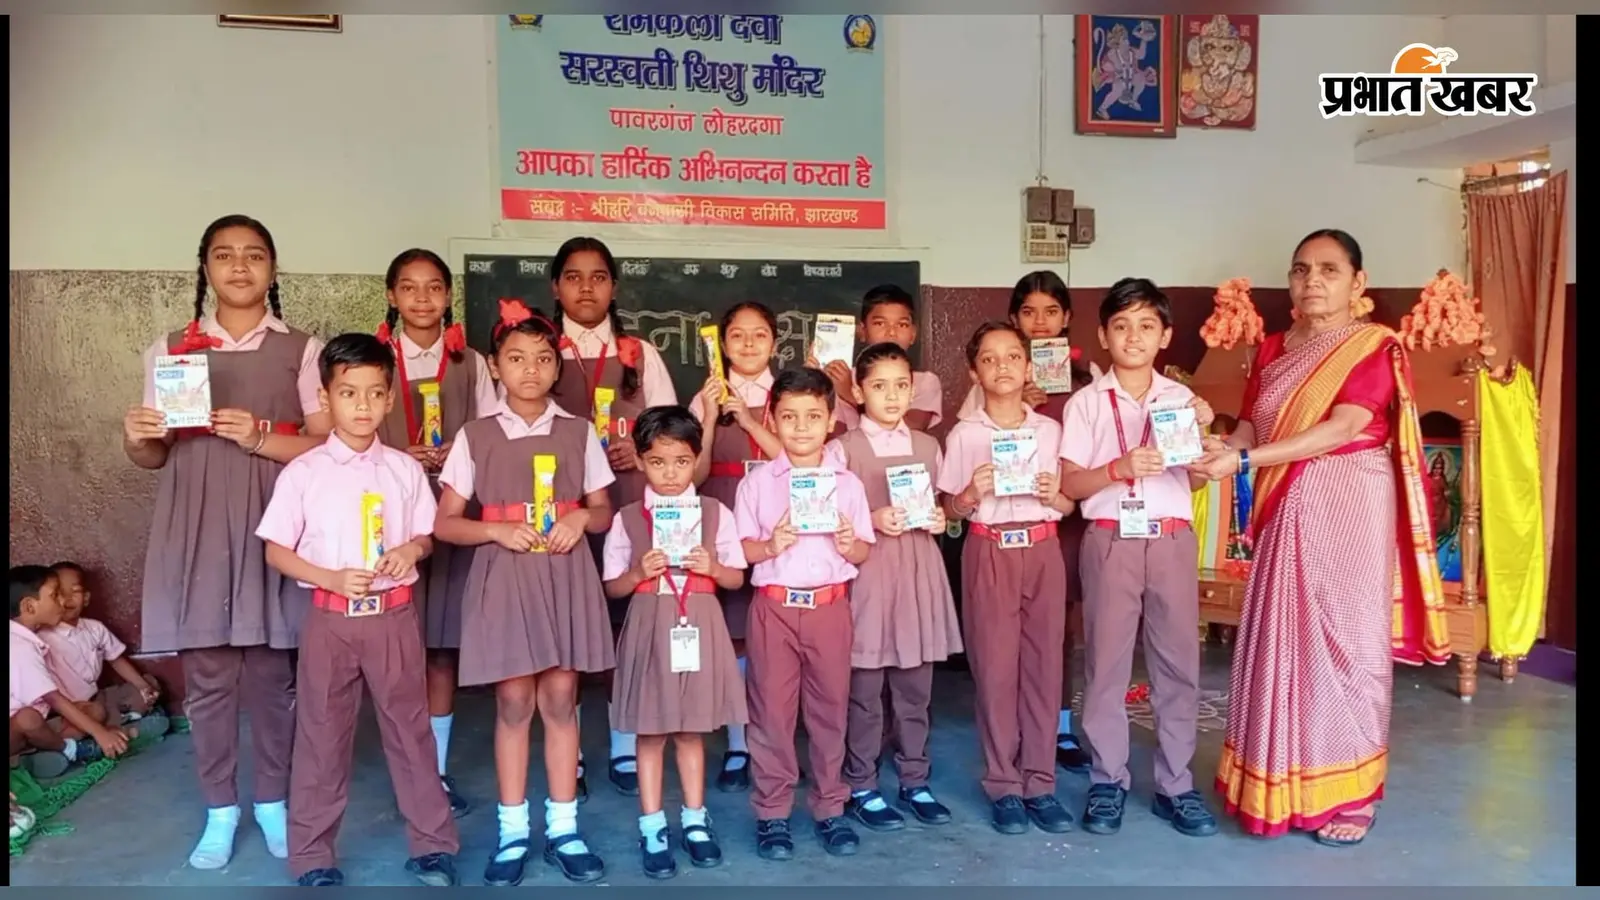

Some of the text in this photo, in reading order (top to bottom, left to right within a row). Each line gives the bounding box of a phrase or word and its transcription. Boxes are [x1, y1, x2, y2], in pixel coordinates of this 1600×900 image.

[559, 48, 678, 89] सरस्वती
[683, 50, 748, 105] शिशु
[609, 104, 784, 136] पावरगंज लोहरदगा
[516, 146, 872, 188] आपका हार्दिक अभिनन्दन करता है
[701, 200, 745, 221] विकास
[750, 202, 799, 223] समिति,
[804, 207, 858, 224] झारखण्ड
